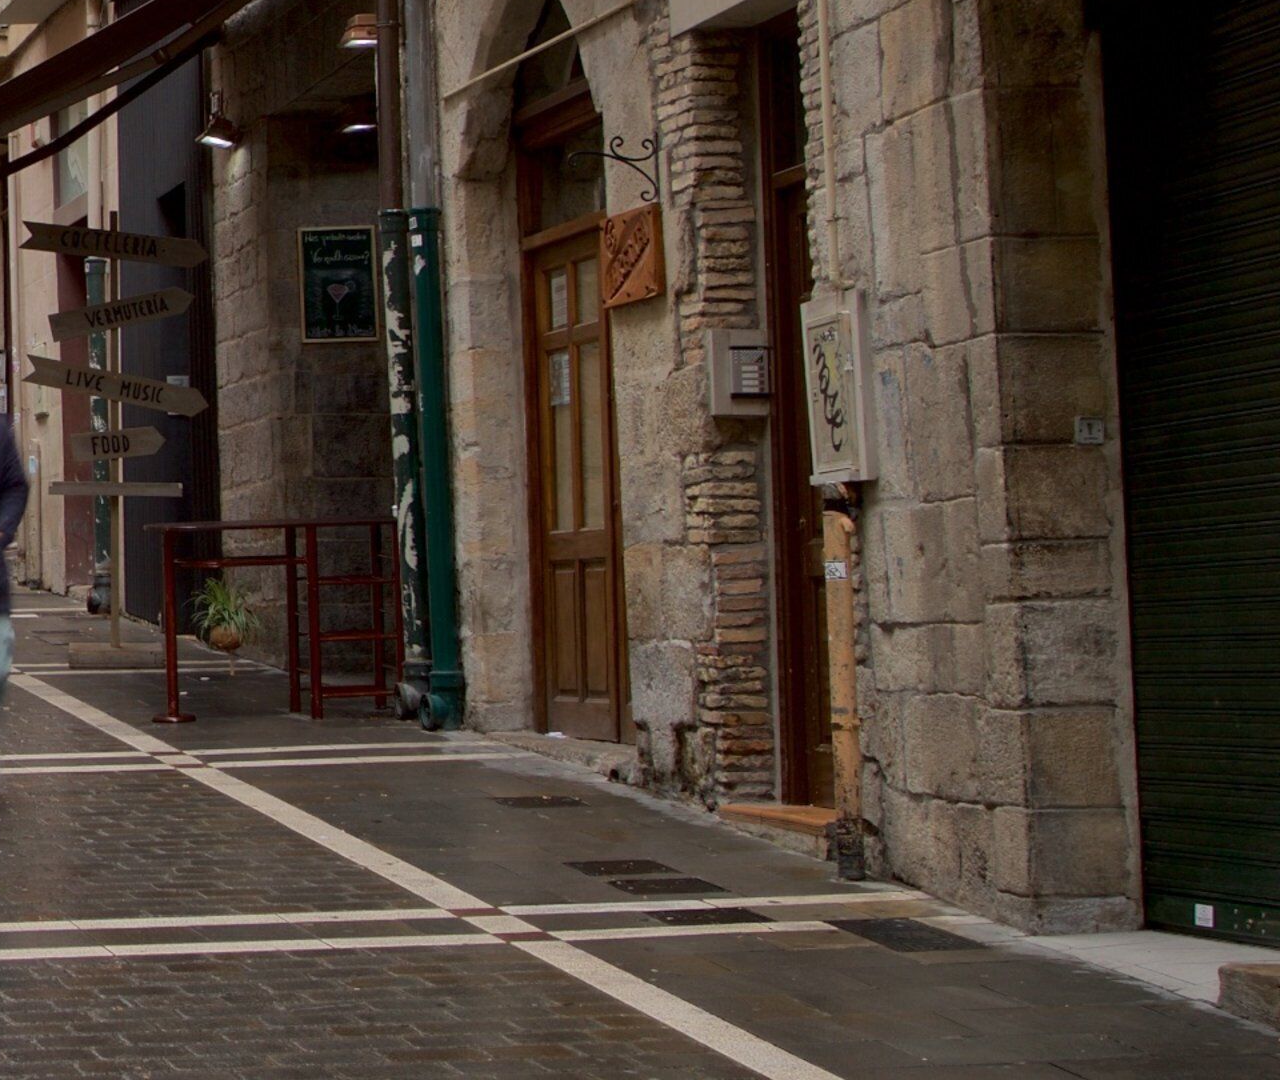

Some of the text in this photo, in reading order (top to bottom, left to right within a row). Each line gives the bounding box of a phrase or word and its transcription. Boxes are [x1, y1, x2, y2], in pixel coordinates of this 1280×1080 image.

[84, 294, 170, 329] VERMUTERÍA
[65, 368, 165, 404] LIVE MUSIC
[91, 435, 130, 456] FOOD
